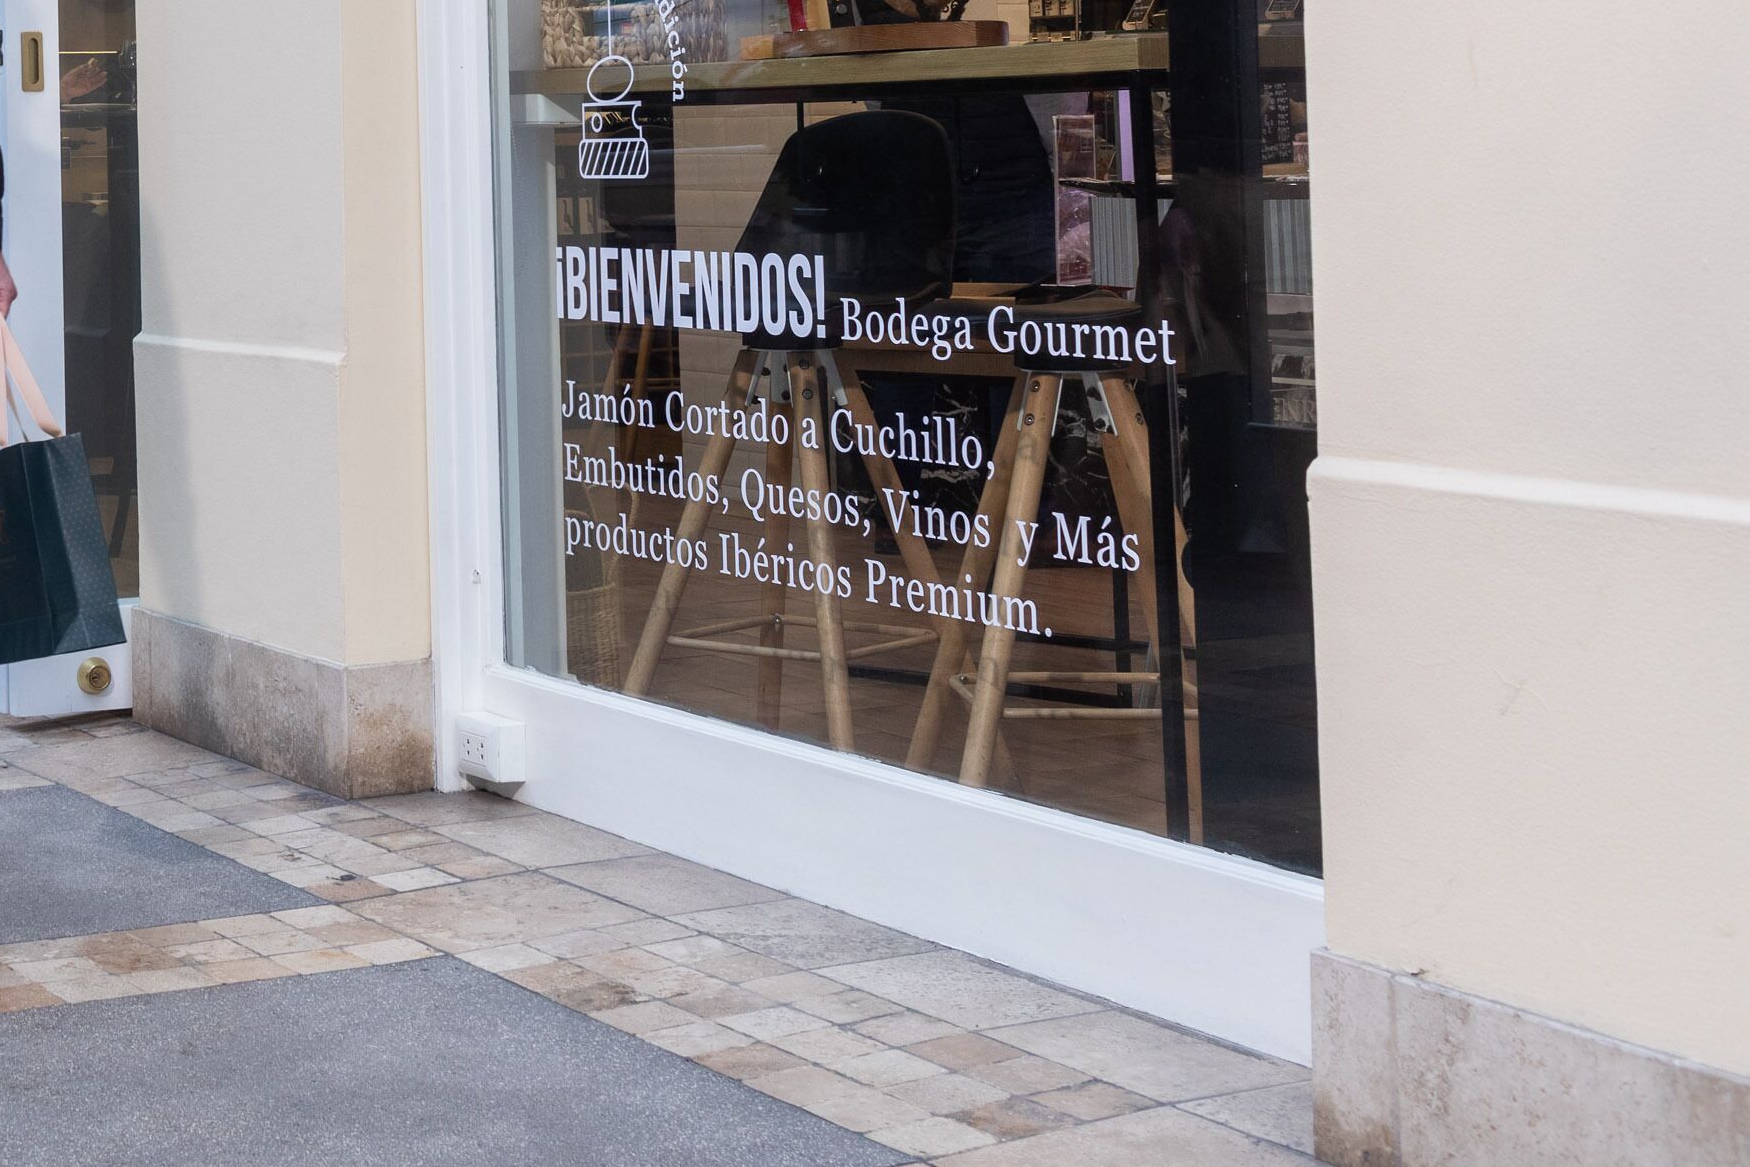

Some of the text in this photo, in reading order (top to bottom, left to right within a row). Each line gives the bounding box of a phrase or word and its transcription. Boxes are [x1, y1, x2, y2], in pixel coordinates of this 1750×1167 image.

[556, 246, 1177, 365] ¡BIENVENIDOS! Bodega Gourmet
[562, 380, 996, 481] Jamón Cortado a Cuchillo,
[563, 442, 1141, 572] Embutidos, Quesos, Vinos y Más
[565, 512, 1053, 638] productos Ibéricos Premium.
